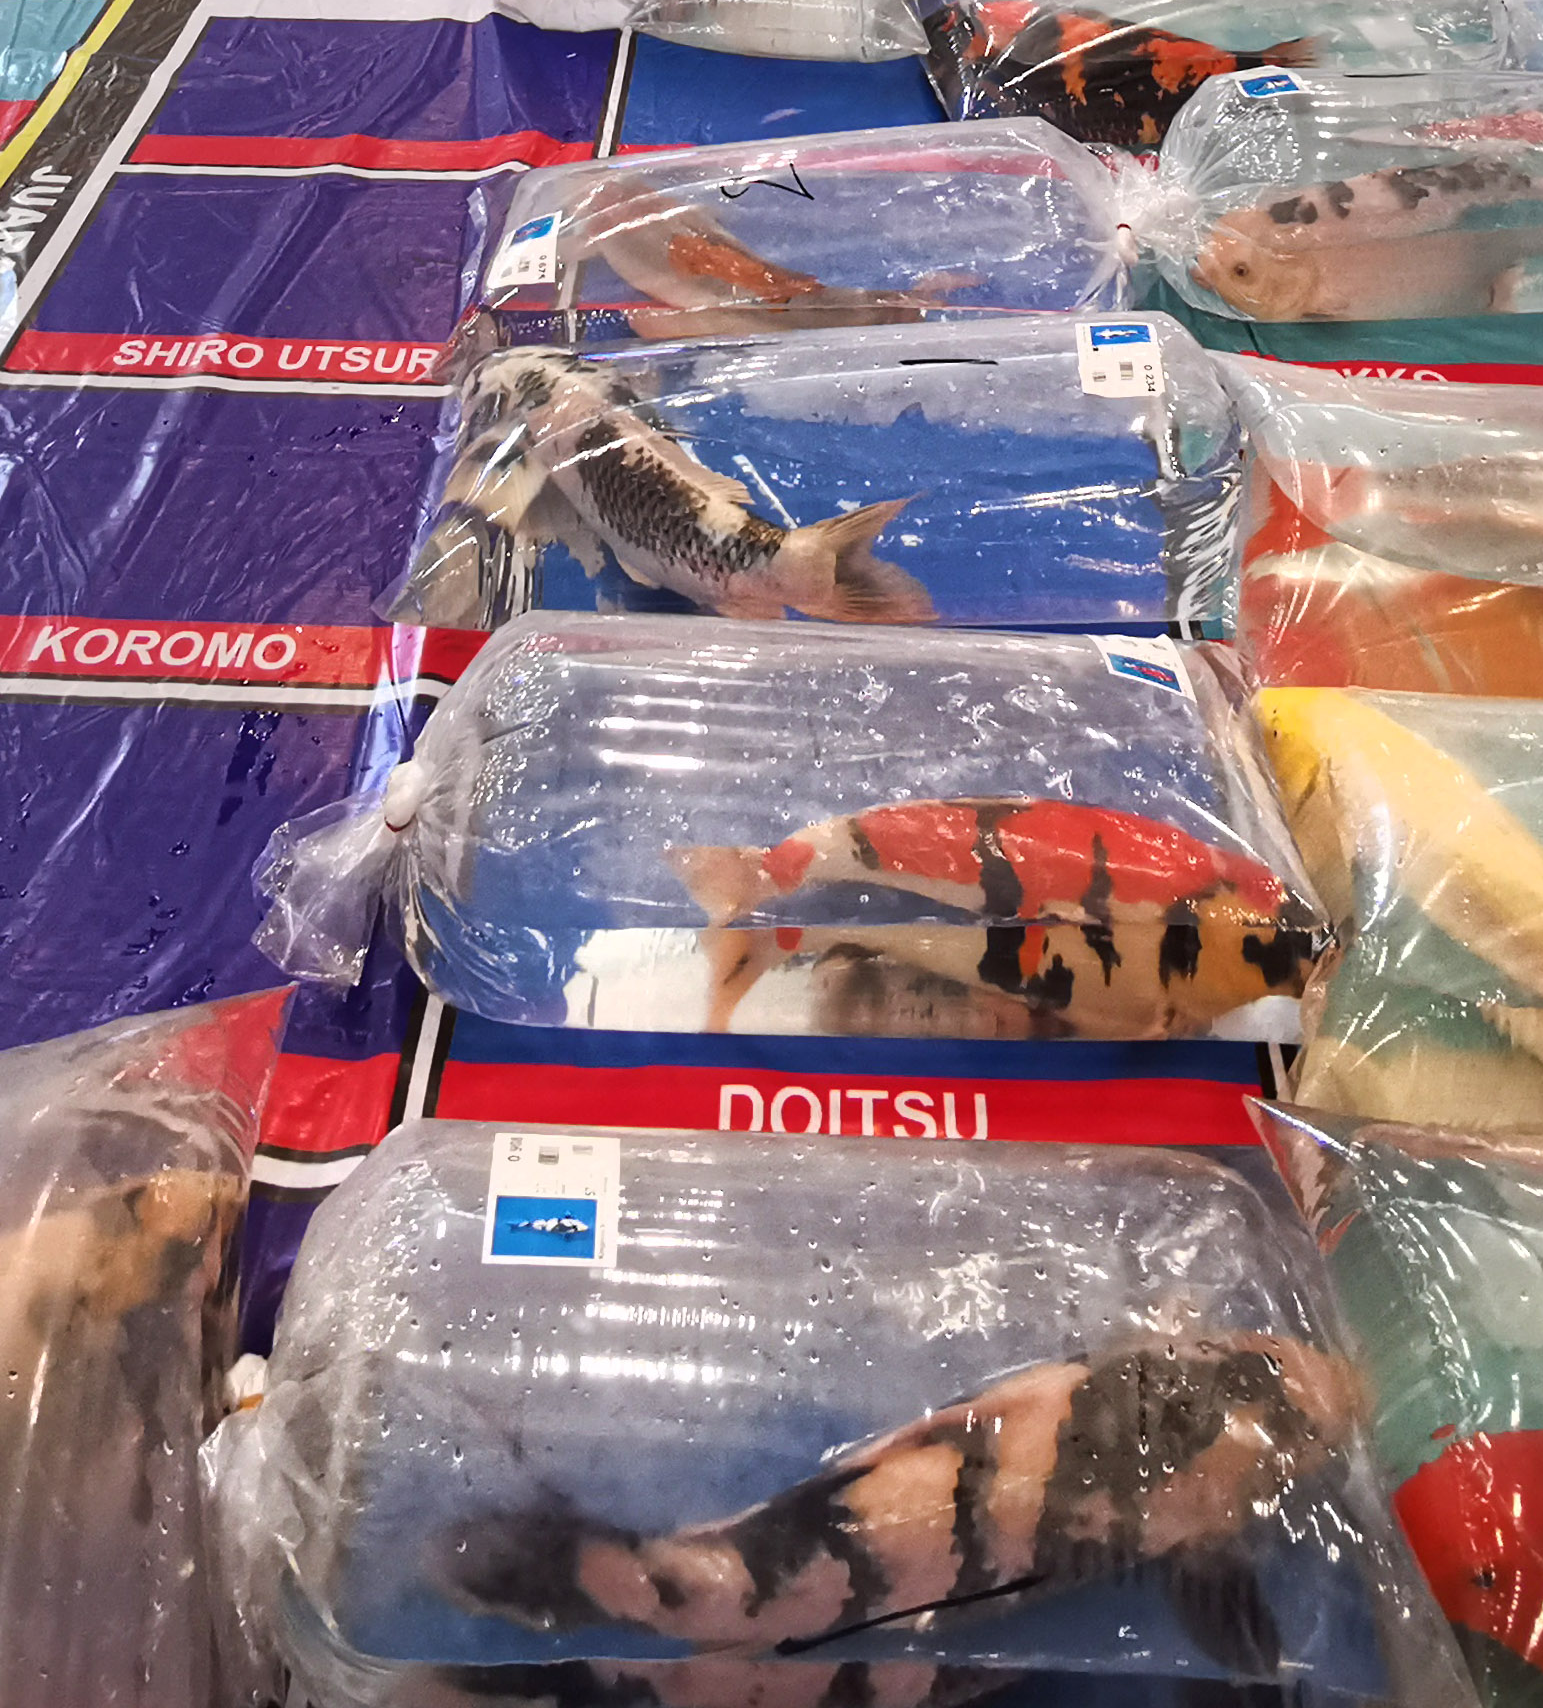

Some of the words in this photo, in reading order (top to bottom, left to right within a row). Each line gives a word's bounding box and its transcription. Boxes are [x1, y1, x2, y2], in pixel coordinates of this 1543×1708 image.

[112, 338, 264, 369] SHIRO
[277, 344, 441, 375] UTSUR
[27, 625, 297, 670] KOROMO
[715, 1083, 991, 1139] DOITSU
